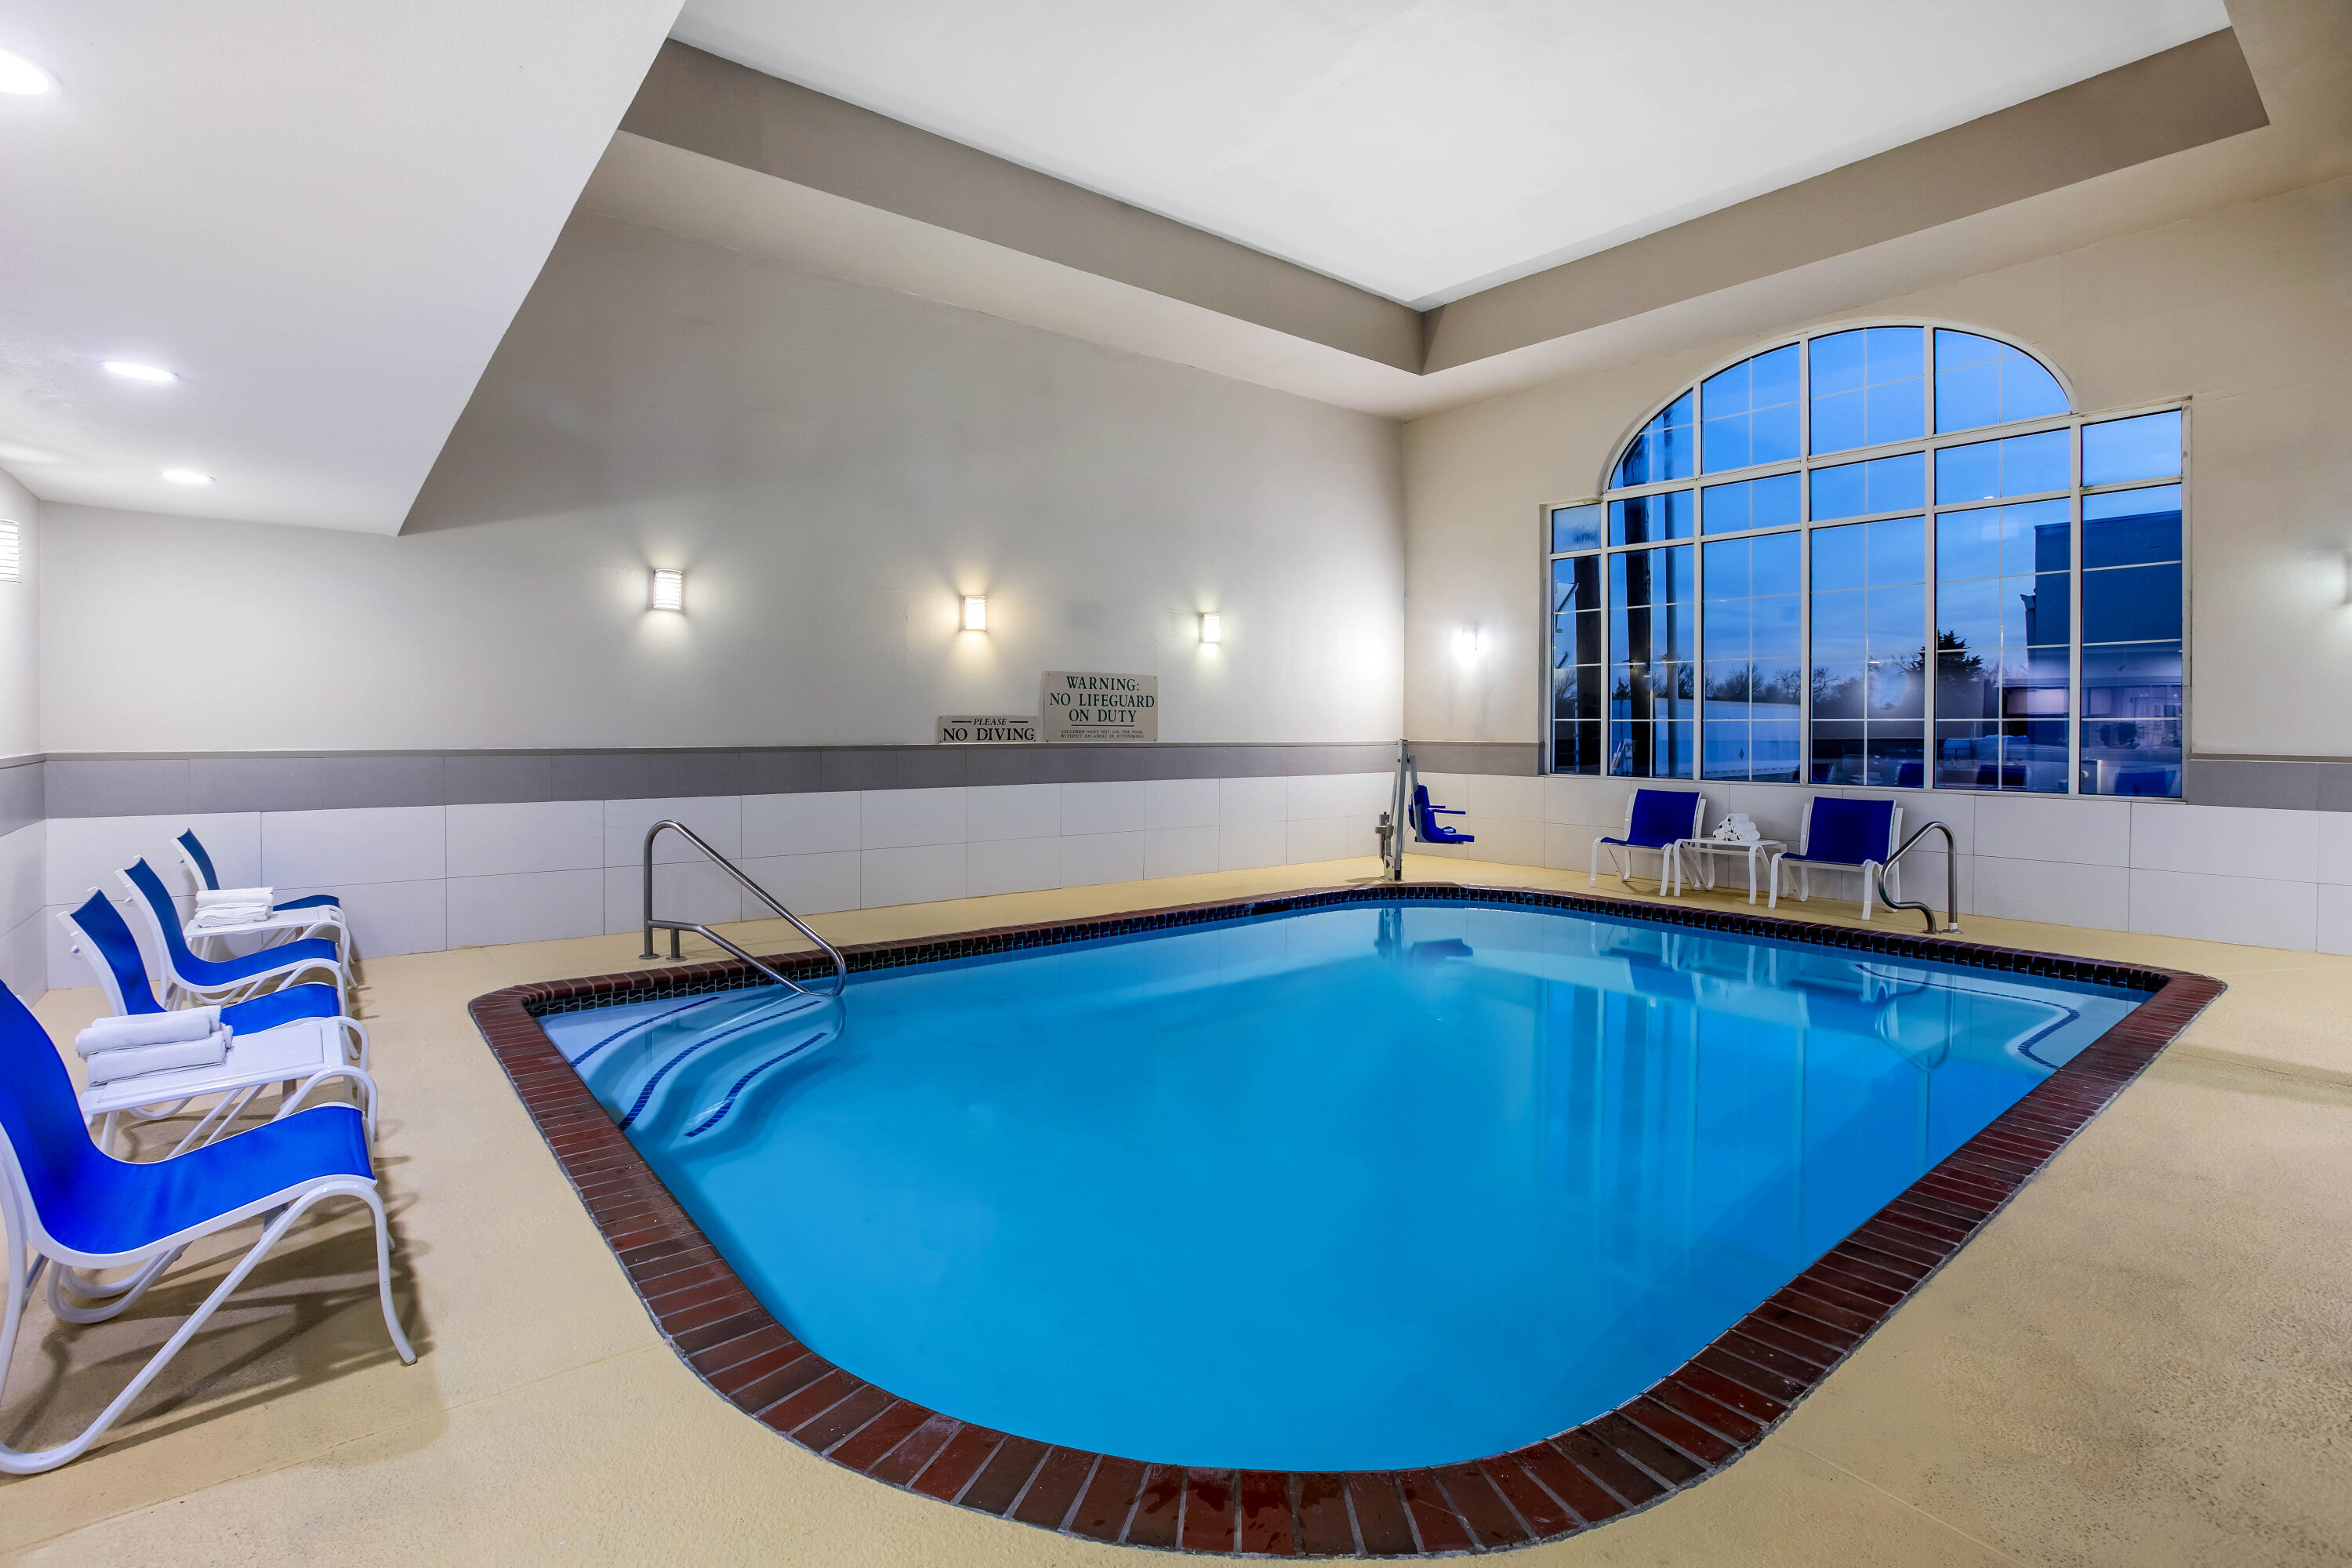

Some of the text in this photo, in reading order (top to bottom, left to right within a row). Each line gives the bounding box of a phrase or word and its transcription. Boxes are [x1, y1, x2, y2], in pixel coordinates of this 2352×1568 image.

[1066, 676, 1139, 691] WARNING:
[1050, 692, 1154, 708] NO LIFEGUARD
[1069, 709, 1137, 722] ON DUTY
[943, 728, 1034, 741] NO DIVING
